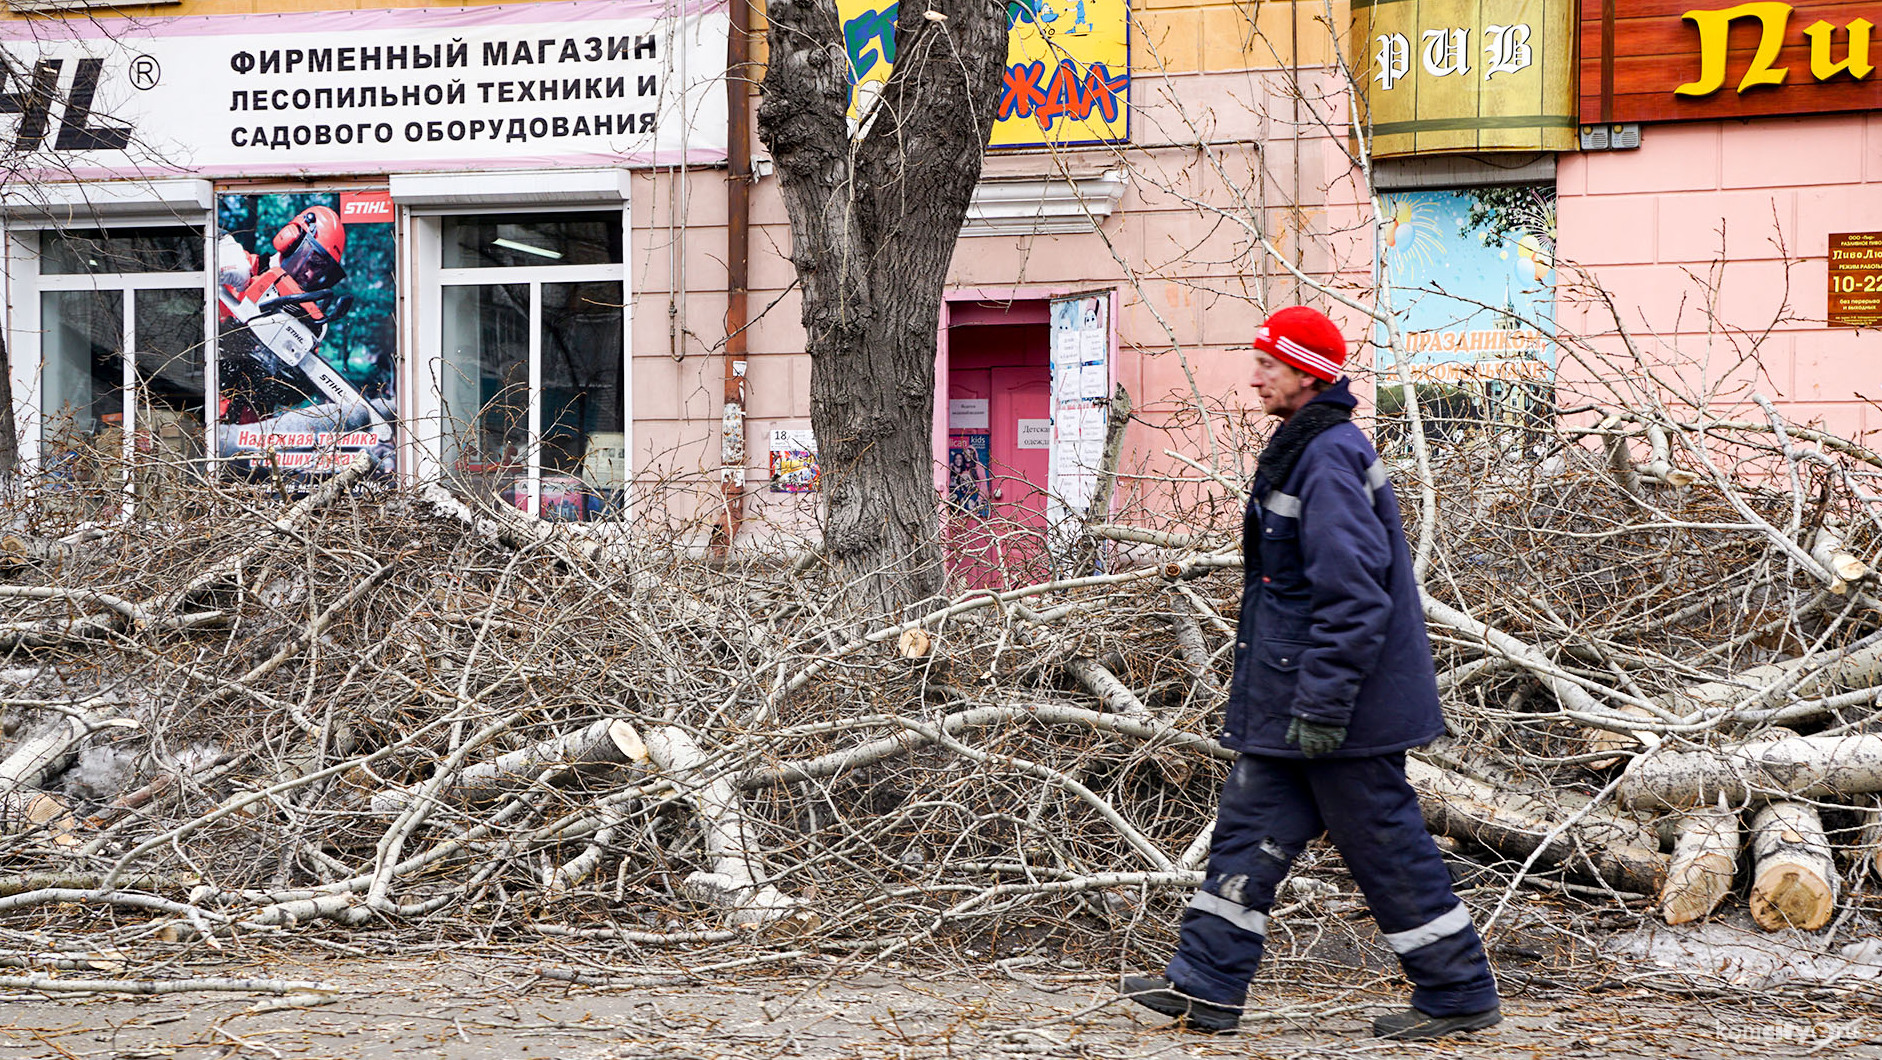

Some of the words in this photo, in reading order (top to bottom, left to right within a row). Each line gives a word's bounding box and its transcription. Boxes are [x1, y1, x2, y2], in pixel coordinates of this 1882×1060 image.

[230, 37, 468, 75] ФИРМЕННЫЙ
[483, 34, 657, 67] МАГАЗИН
[229, 78, 466, 111] ЛЕСОПИЛЬНОЙ
[477, 76, 625, 104] ТЕХНИКИ
[637, 75, 657, 97] И
[231, 122, 394, 150] САДОВОГО
[404, 112, 657, 144] ОБОРУДОВАНИЯ
[344, 201, 389, 215] STIHL
[285, 325, 304, 344] STIHL
[319, 374, 344, 397] STIHL
[238, 431, 315, 448] Надежная
[318, 432, 378, 446] техника
[775, 430, 787, 440] 18
